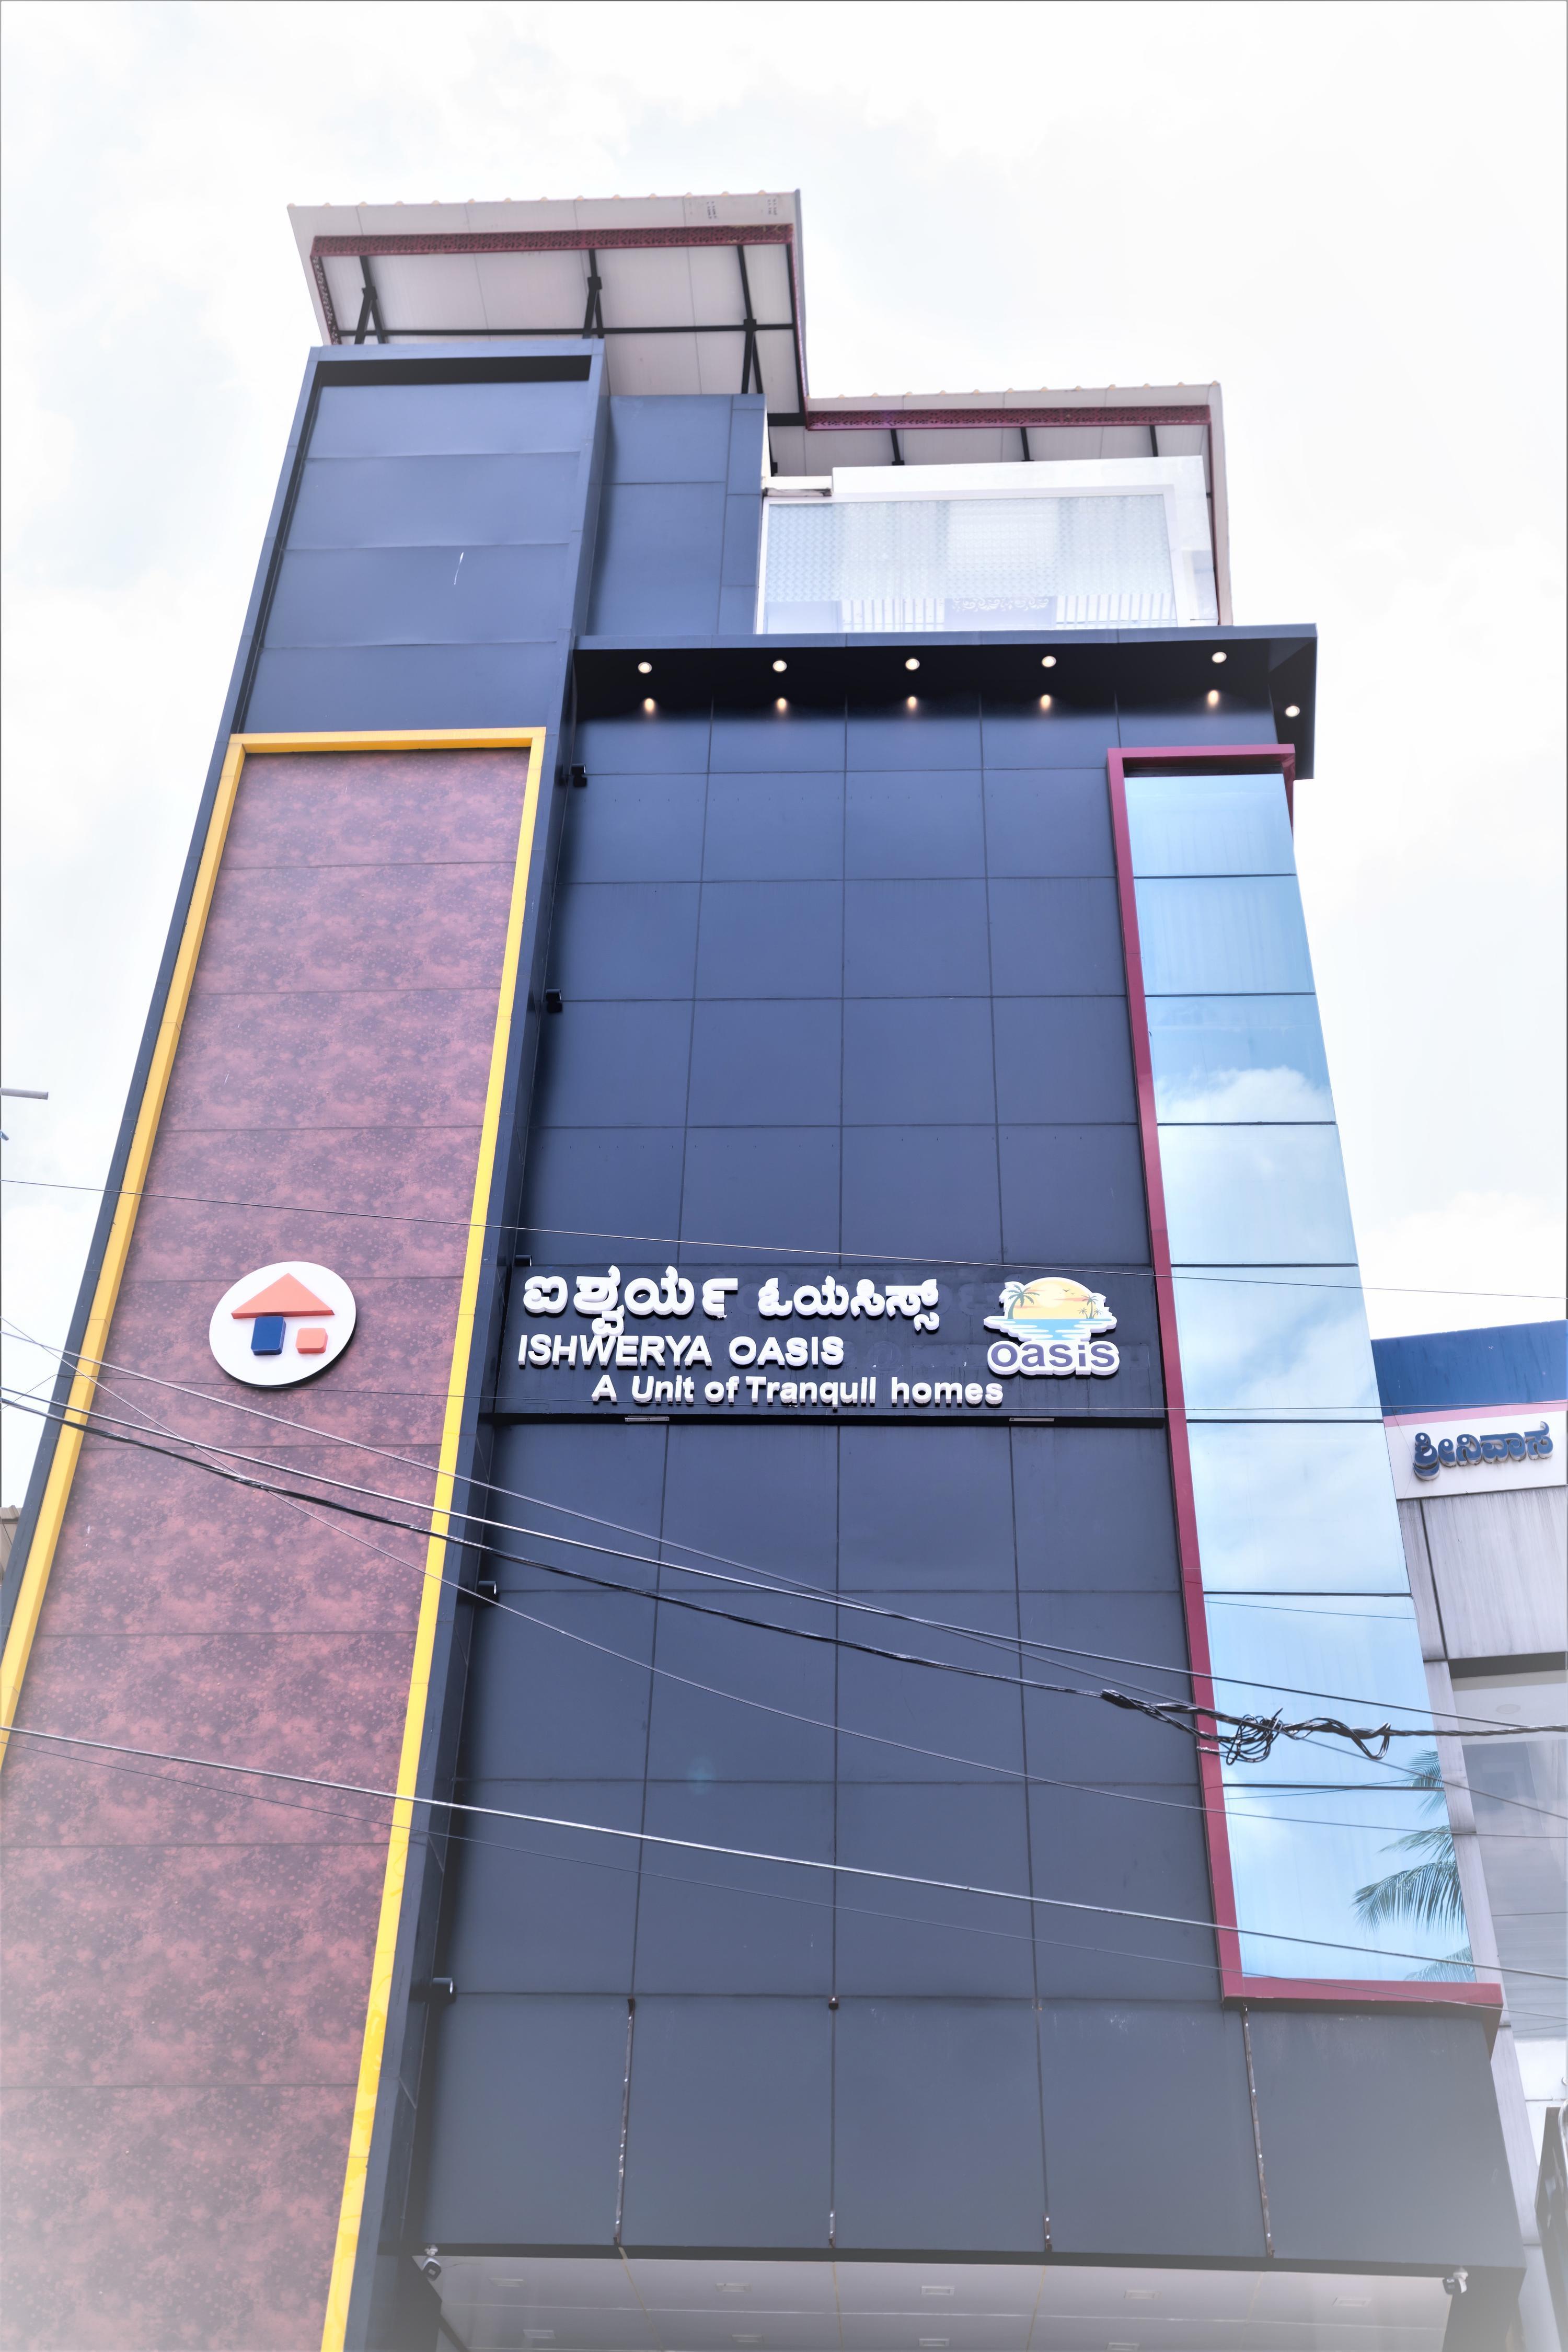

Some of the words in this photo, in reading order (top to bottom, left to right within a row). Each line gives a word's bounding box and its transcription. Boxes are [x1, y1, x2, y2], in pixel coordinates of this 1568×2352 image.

[523, 1265, 737, 1338] ಐಶ್ವರ್ಯ
[518, 1334, 712, 1366] ISHWERYA
[729, 1336, 844, 1366] OASIS
[591, 1375, 617, 1402] A
[632, 1375, 694, 1403] Unit
[705, 1376, 740, 1403] of
[745, 1376, 876, 1409] Tranquil
[892, 1377, 1003, 1404] homes
[1413, 1421, 1553, 1480] ಶ್ರೀನಿವಾಸ
